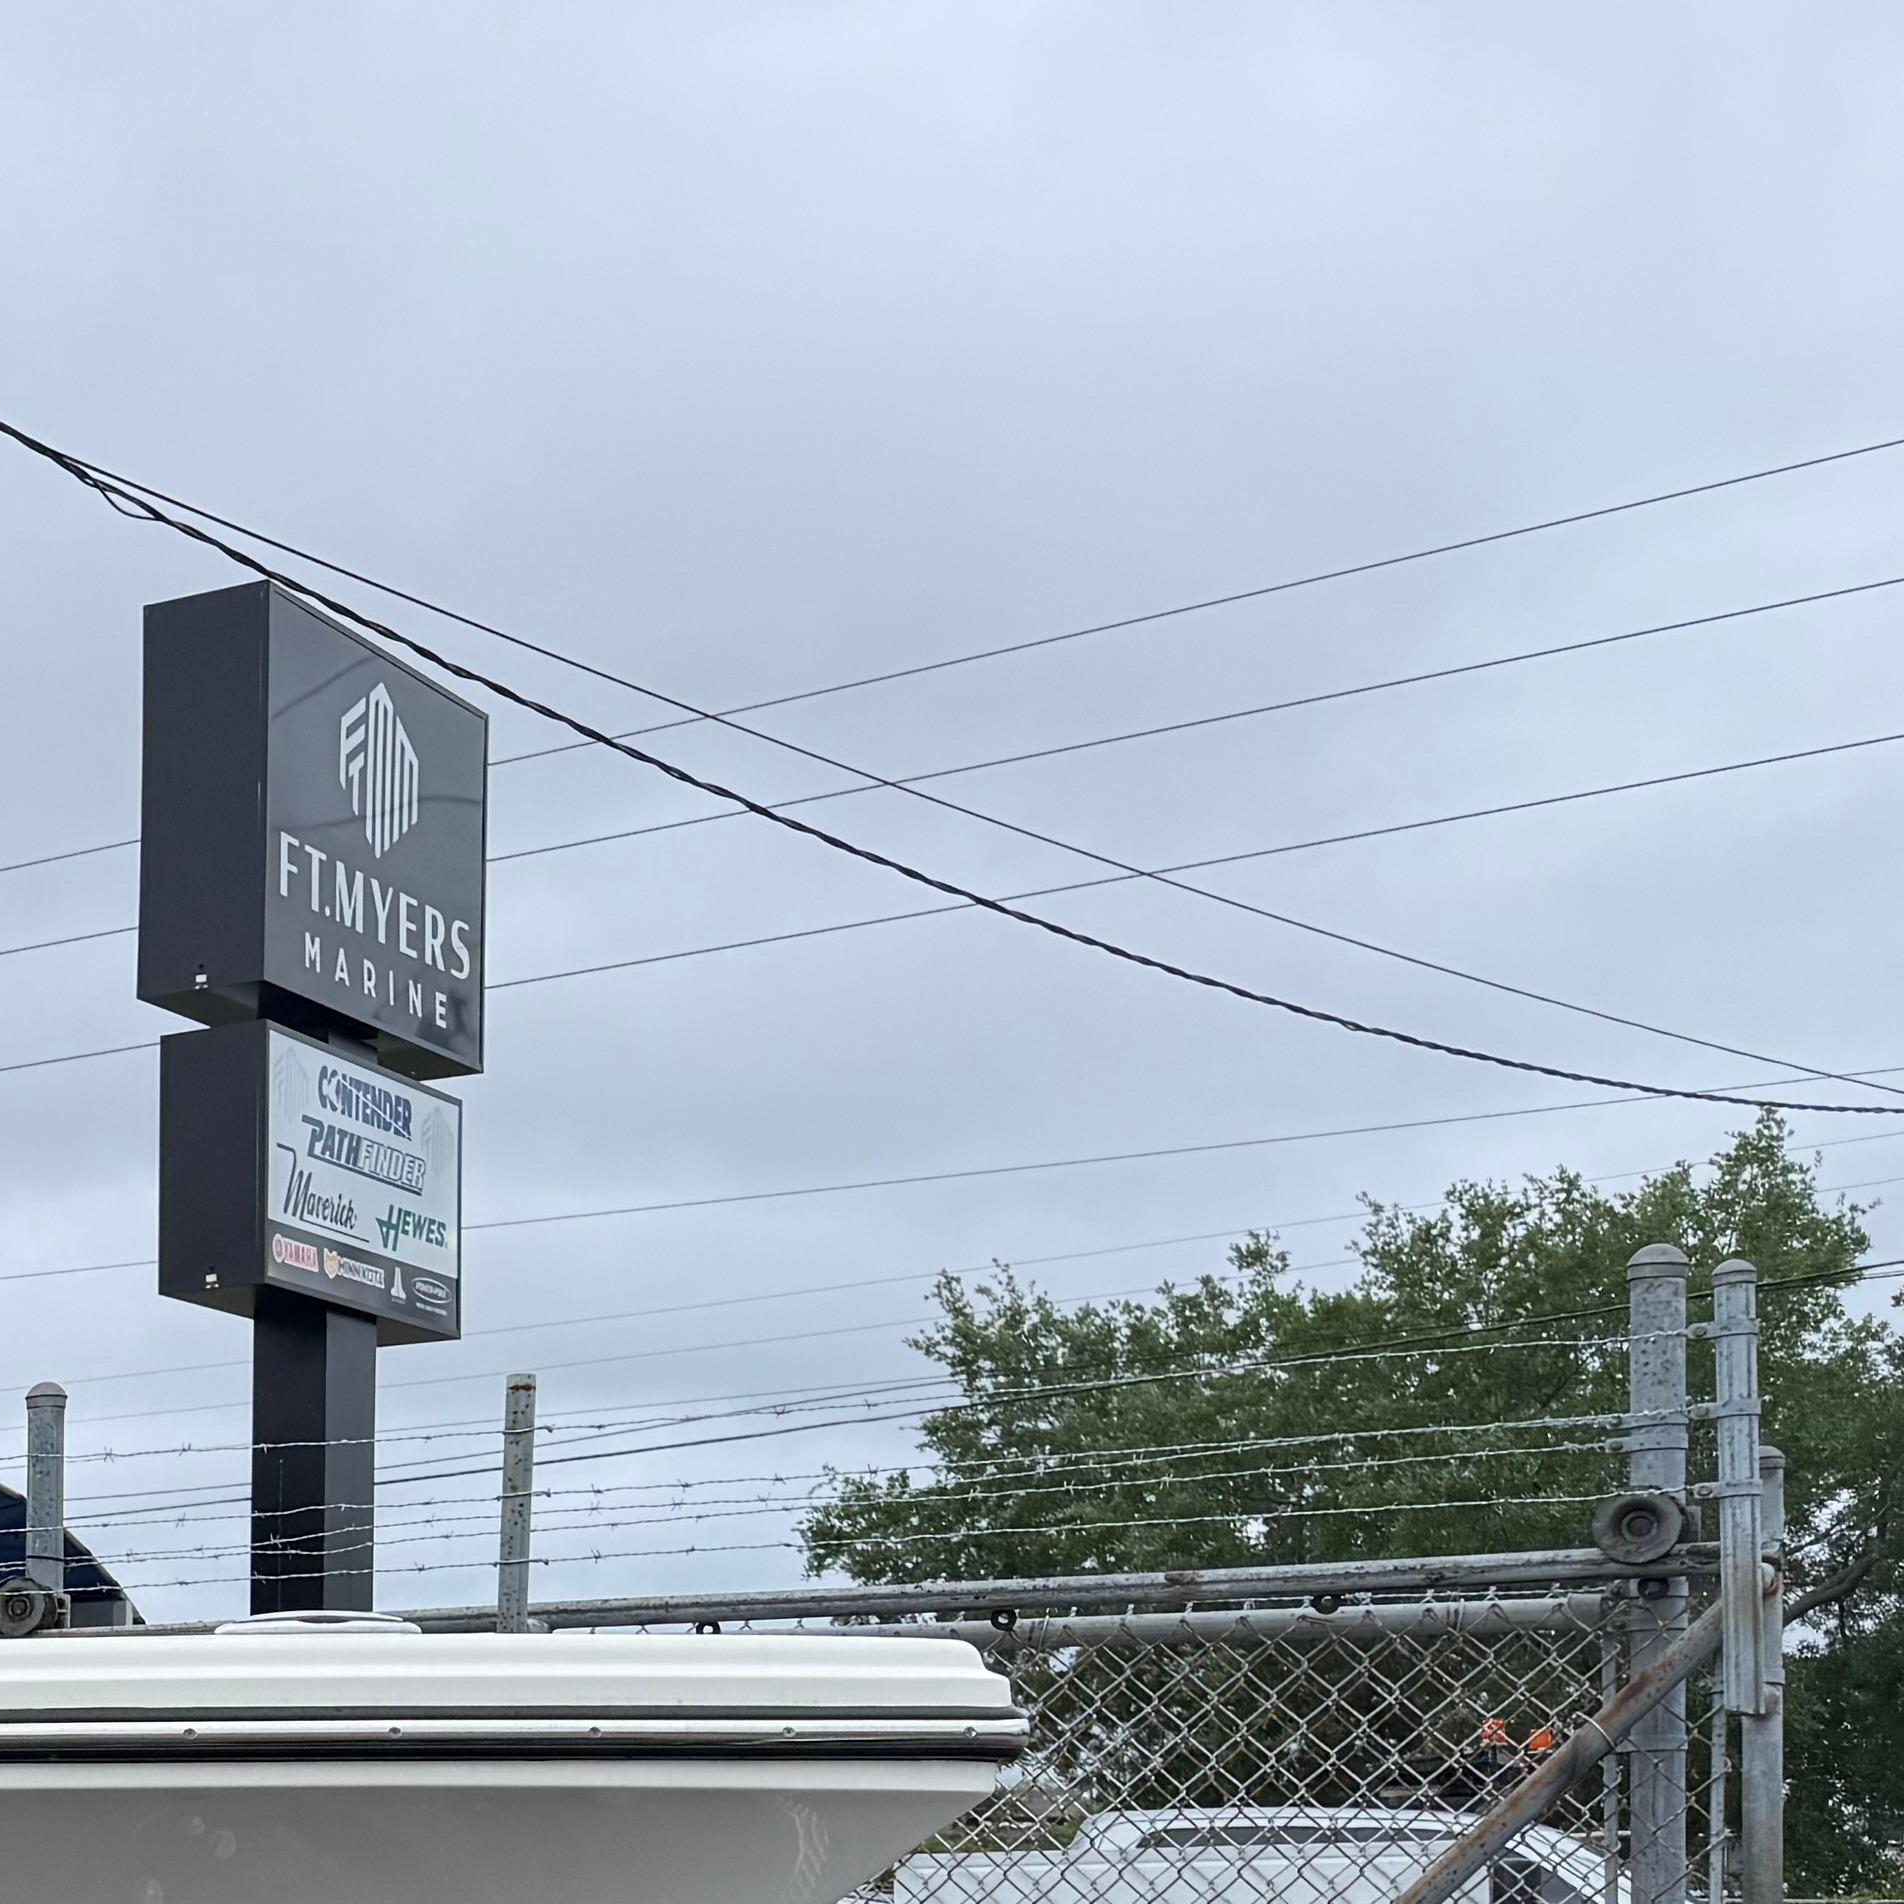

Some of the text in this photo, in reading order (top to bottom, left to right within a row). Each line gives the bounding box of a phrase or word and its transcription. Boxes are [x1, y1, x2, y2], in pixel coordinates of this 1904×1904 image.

[304, 931, 448, 1029] MARINE
[318, 1065, 413, 1142] CONTENDER
[276, 1141, 371, 1244] Maverick
[301, 1114, 426, 1196] PATHFINDER
